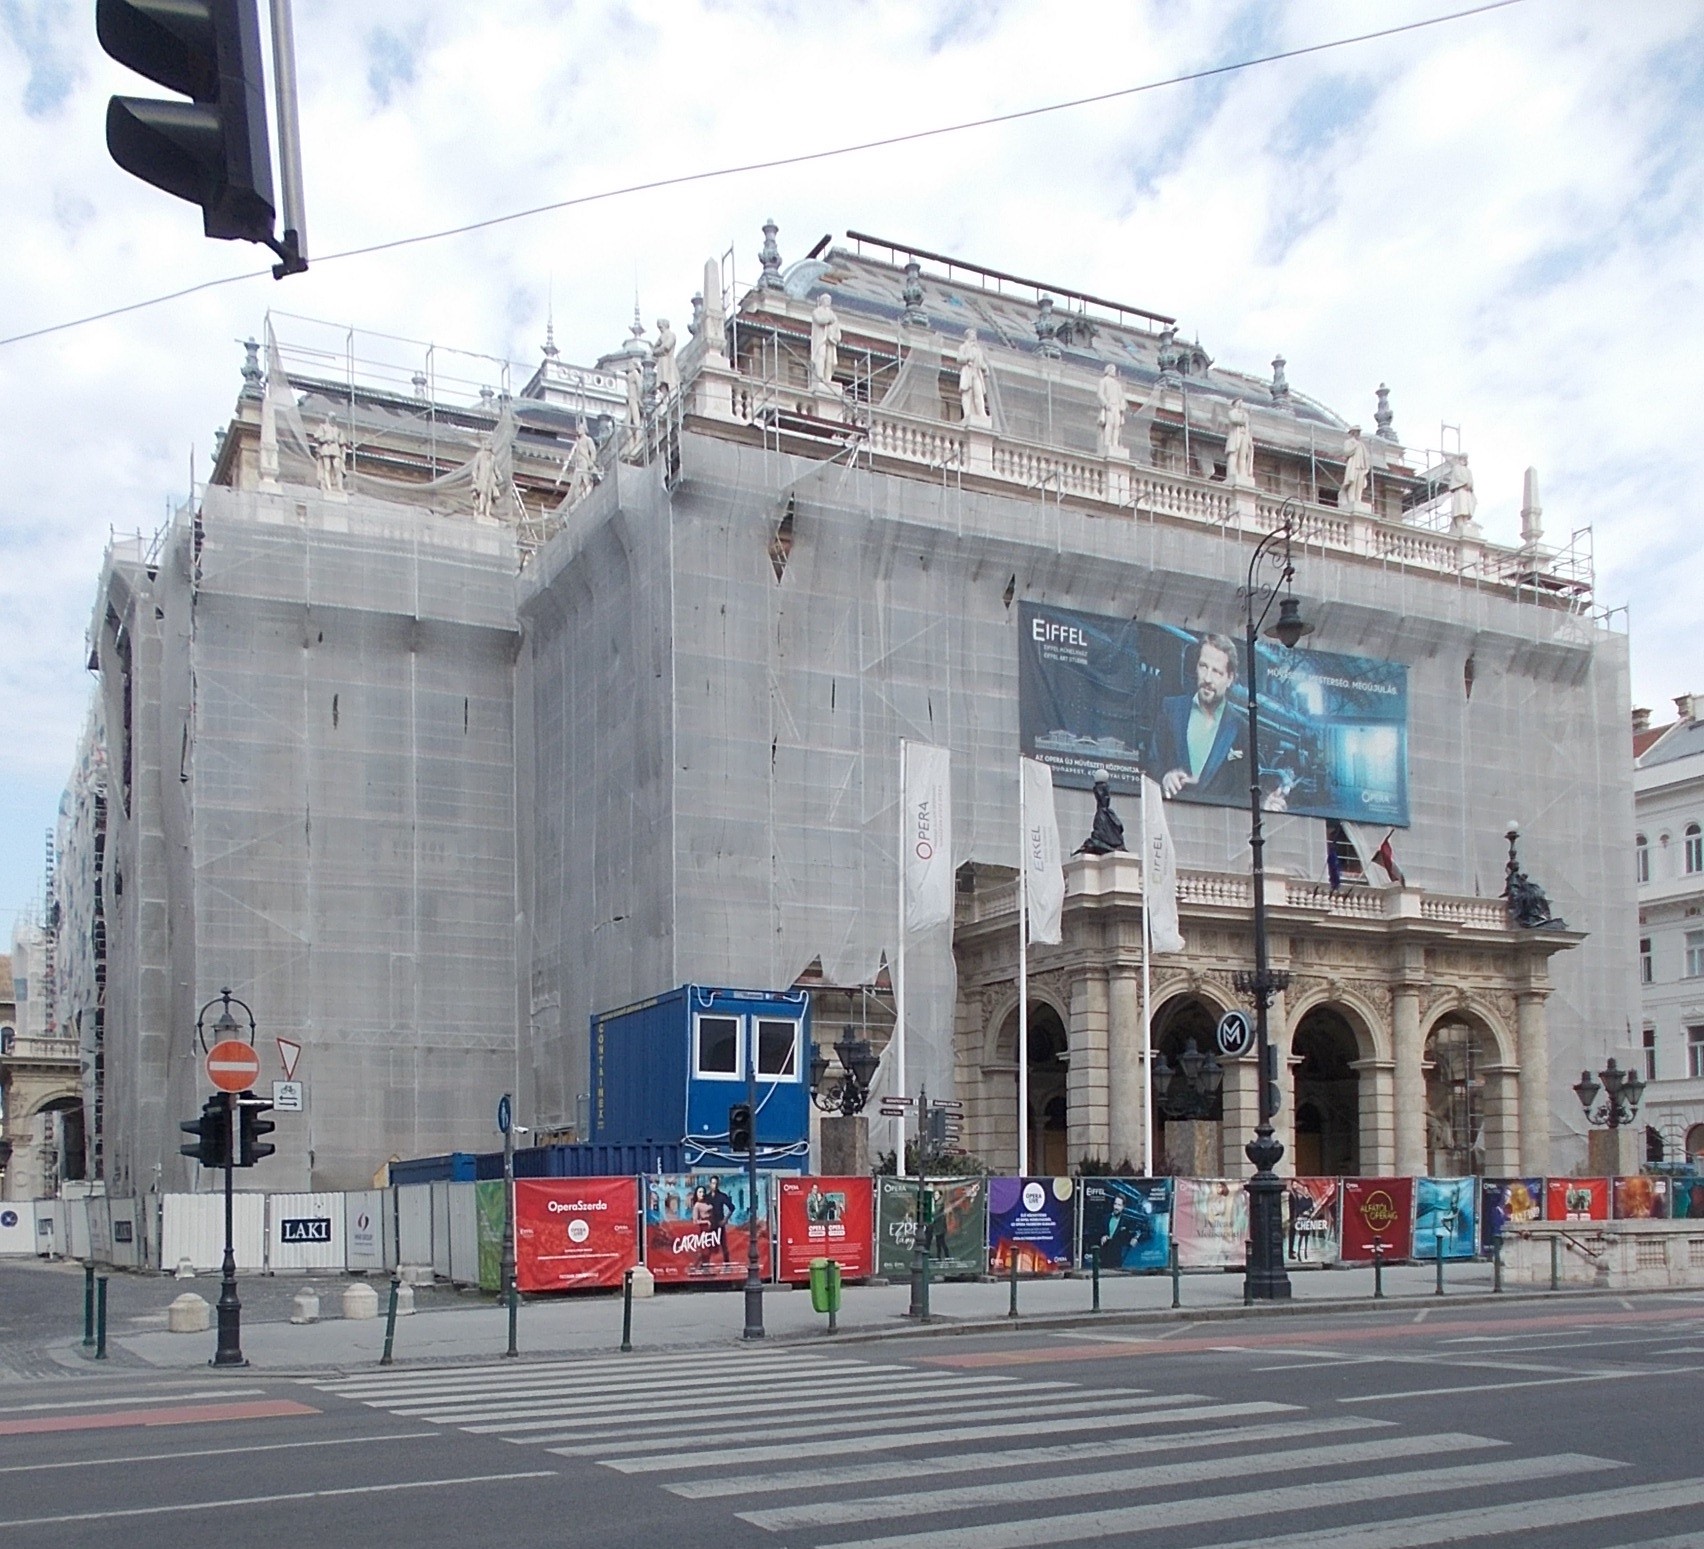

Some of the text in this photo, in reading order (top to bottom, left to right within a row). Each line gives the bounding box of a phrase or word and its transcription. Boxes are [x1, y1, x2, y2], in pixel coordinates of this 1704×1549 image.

[1032, 618, 1088, 647] EIFFEL
[1044, 756, 1064, 764] OPERA
[916, 801, 933, 860] OPERA
[1031, 825, 1044, 872] ERKEL
[1222, 1020, 1241, 1046] M
[884, 1184, 906, 1192] OPERA
[1086, 1187, 1105, 1196] EIFFEL
[548, 1200, 608, 1213] OperaSzerda
[284, 1222, 328, 1239] LAKI
[889, 1222, 926, 1236] EZRE
[673, 1228, 722, 1254] CARMEN
